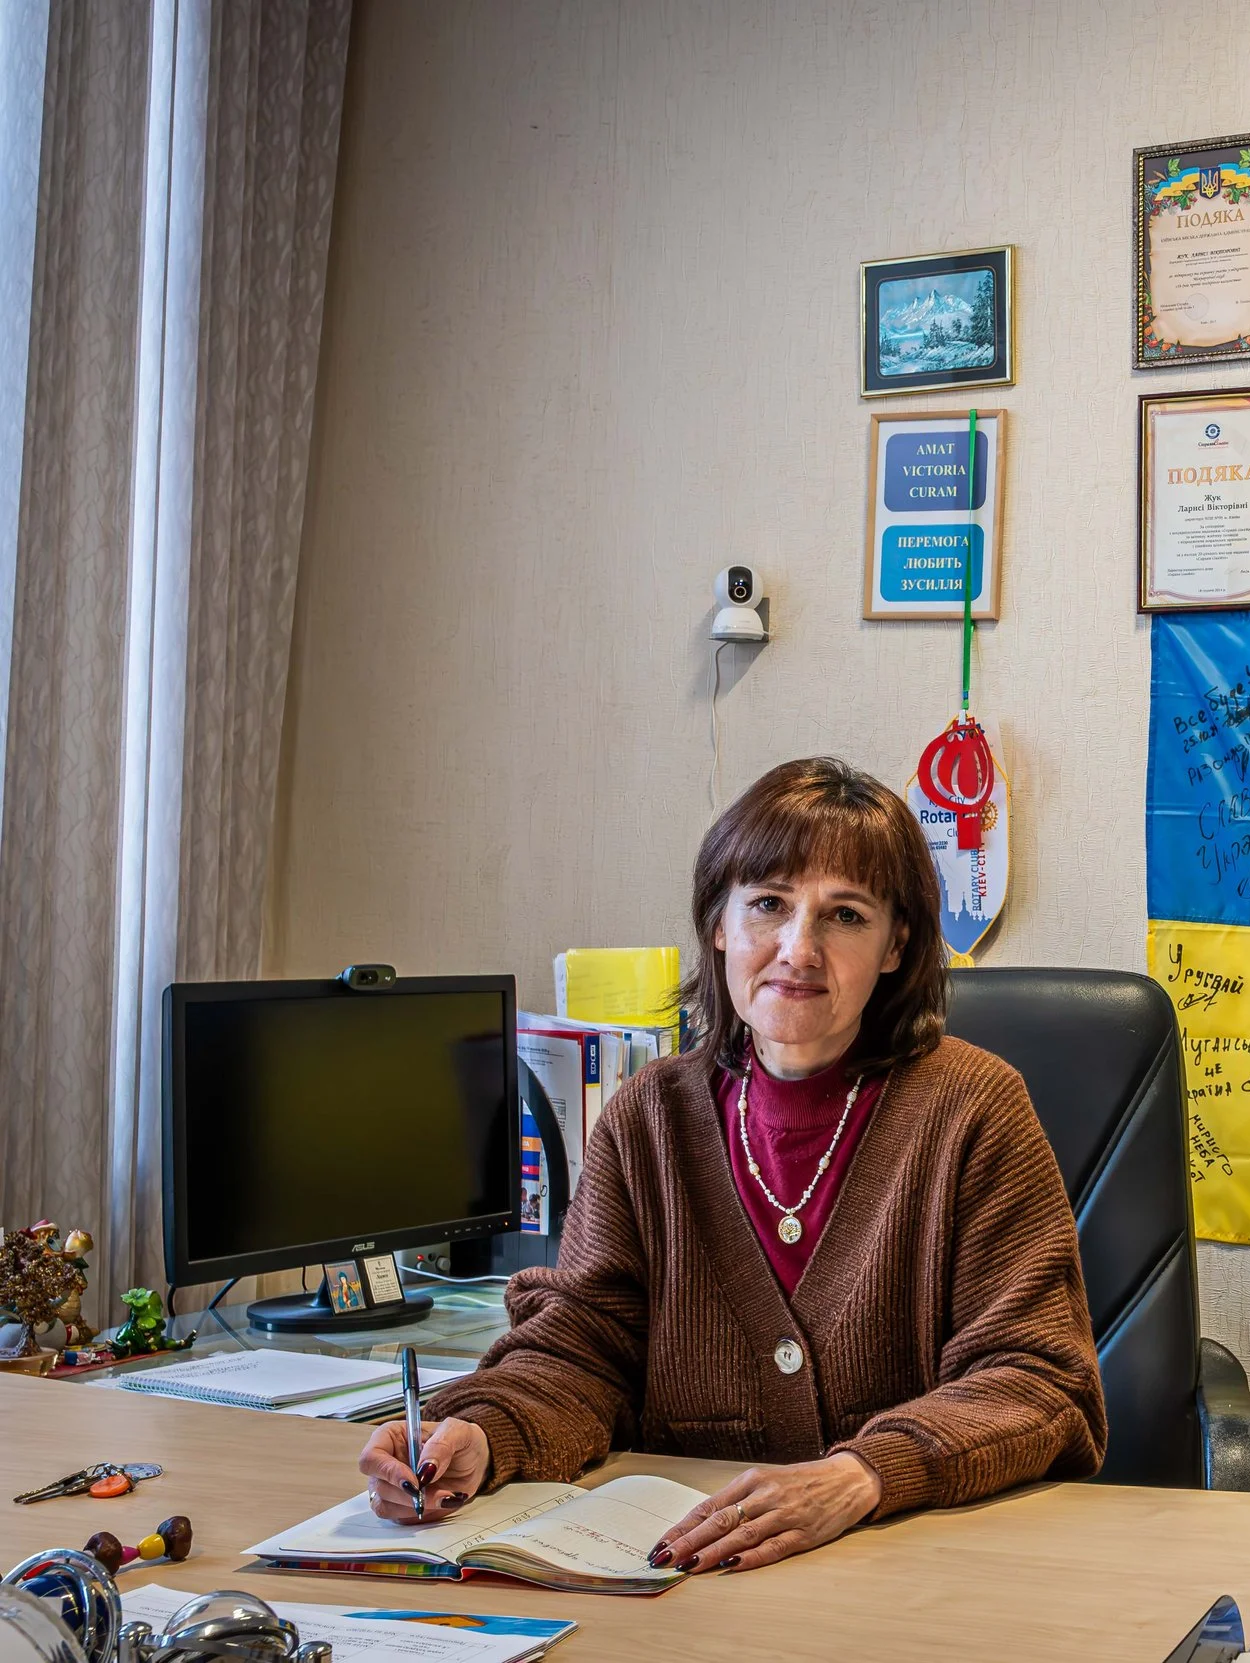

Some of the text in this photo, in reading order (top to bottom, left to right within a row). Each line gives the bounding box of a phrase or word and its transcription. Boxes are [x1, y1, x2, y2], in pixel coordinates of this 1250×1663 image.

[1177, 208, 1245, 228] ПОДЯКА
[916, 443, 955, 456] AMAT
[903, 464, 966, 477] VICTORIA
[909, 486, 958, 498] CURAM
[1178, 502, 1248, 513] Ларисі Вікторівні
[898, 535, 969, 549] ПЕРЕМОГА
[903, 557, 962, 570] ЛЮБИТЬ
[900, 579, 964, 592] ЗУСИЛЛЯ
[1173, 710, 1207, 734] Все
[1204, 683, 1245, 718] буде
[920, 810, 958, 824] Rotar
[970, 850, 982, 912] ROTARY CLUB
[1204, 1062, 1223, 1077] ЦЕ
[351, 1241, 375, 1252] ASUS
